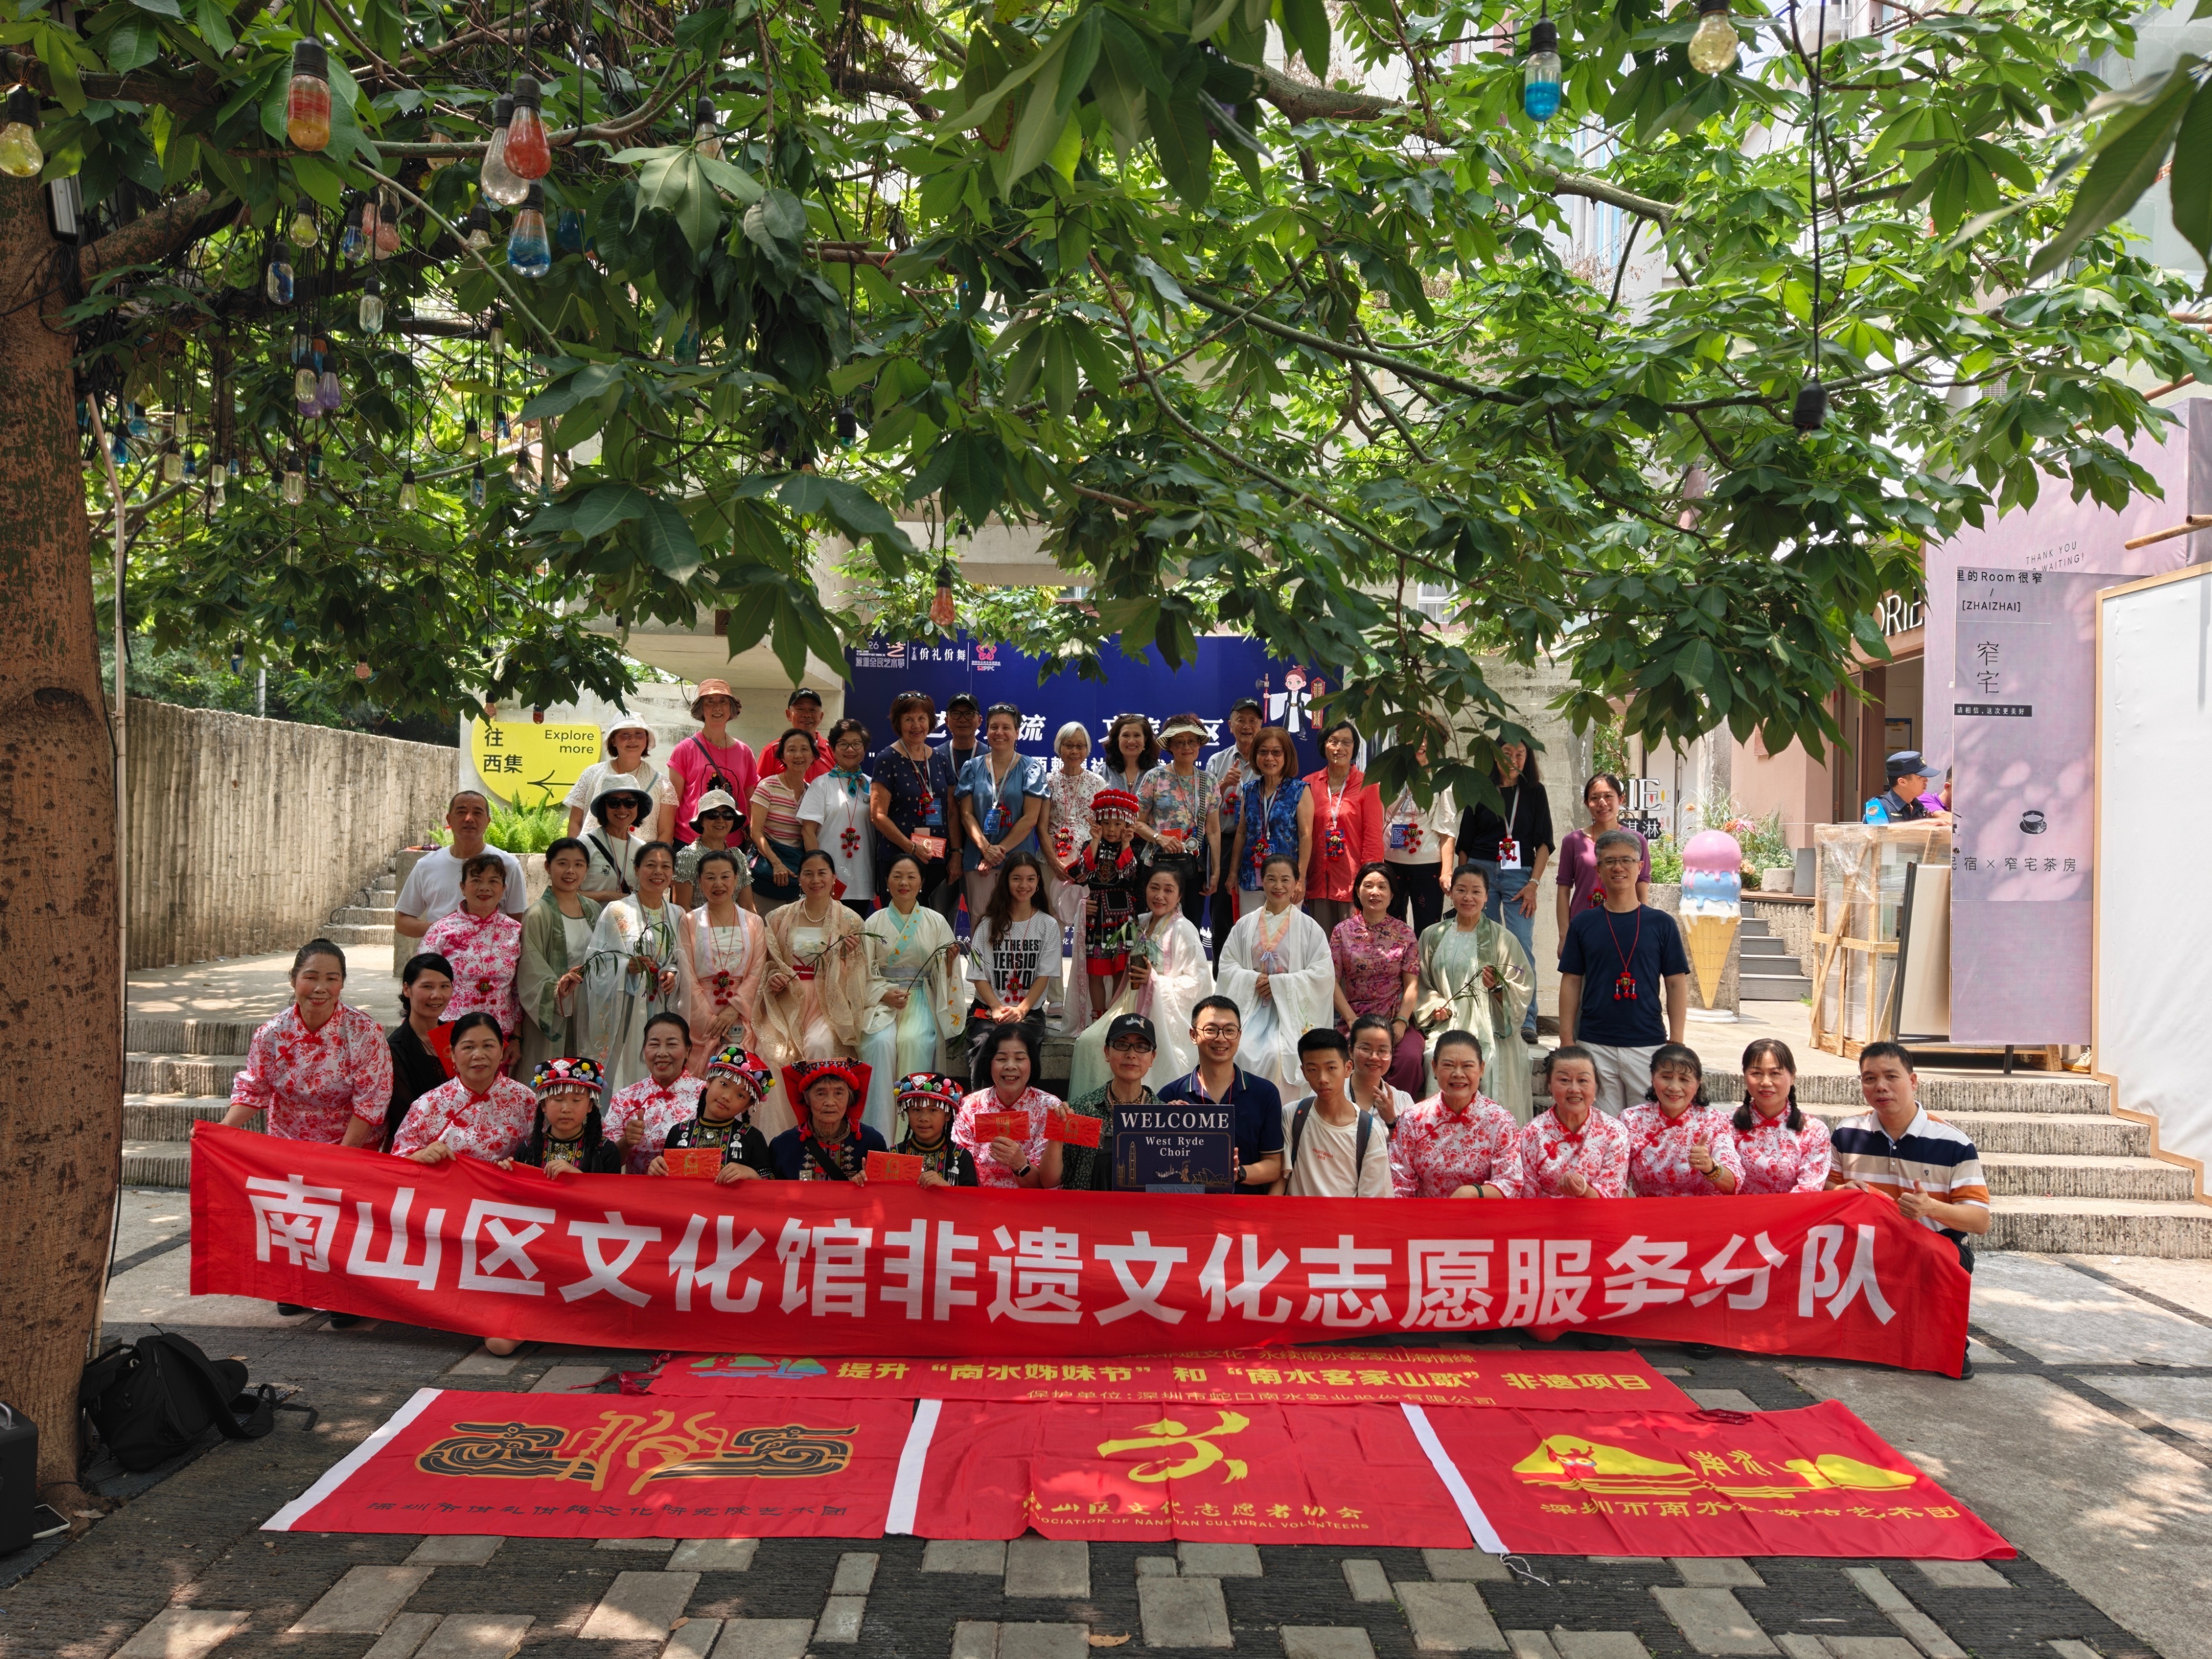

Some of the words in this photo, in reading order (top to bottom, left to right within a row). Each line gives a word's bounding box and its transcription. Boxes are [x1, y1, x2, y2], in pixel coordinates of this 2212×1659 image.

[2026, 549, 2053, 565] THANK
[2059, 541, 2077, 552] YOU
[2042, 552, 2084, 571] WAITING!
[1962, 600, 2021, 612] [ZHAIZHAI]
[1977, 641, 1999, 694] 窄宅
[484, 728, 504, 747] 往
[545, 729, 594, 742] Explore
[560, 744, 594, 754] more
[483, 754, 523, 774] 西集
[1004, 940, 1020, 951] THE
[993, 953, 1040, 969] VERSIO
[994, 970, 1009, 990] OF
[1120, 1113, 1229, 1129] WELCOME
[1146, 1136, 1171, 1145] West
[1178, 1136, 1204, 1147] Ryde
[1160, 1147, 1191, 1156] Choir
[245, 1173, 1897, 1327] 南山区文化馆非遗文化志愿服务分队
[836, 1363, 910, 1380] 提升
[1173, 1367, 1207, 1382] 和
[1501, 1373, 1651, 1390] 非遗项目
[1206, 1519, 1276, 1528] CULTURAL
[1281, 1520, 1369, 1529] VOLUNTEERS
